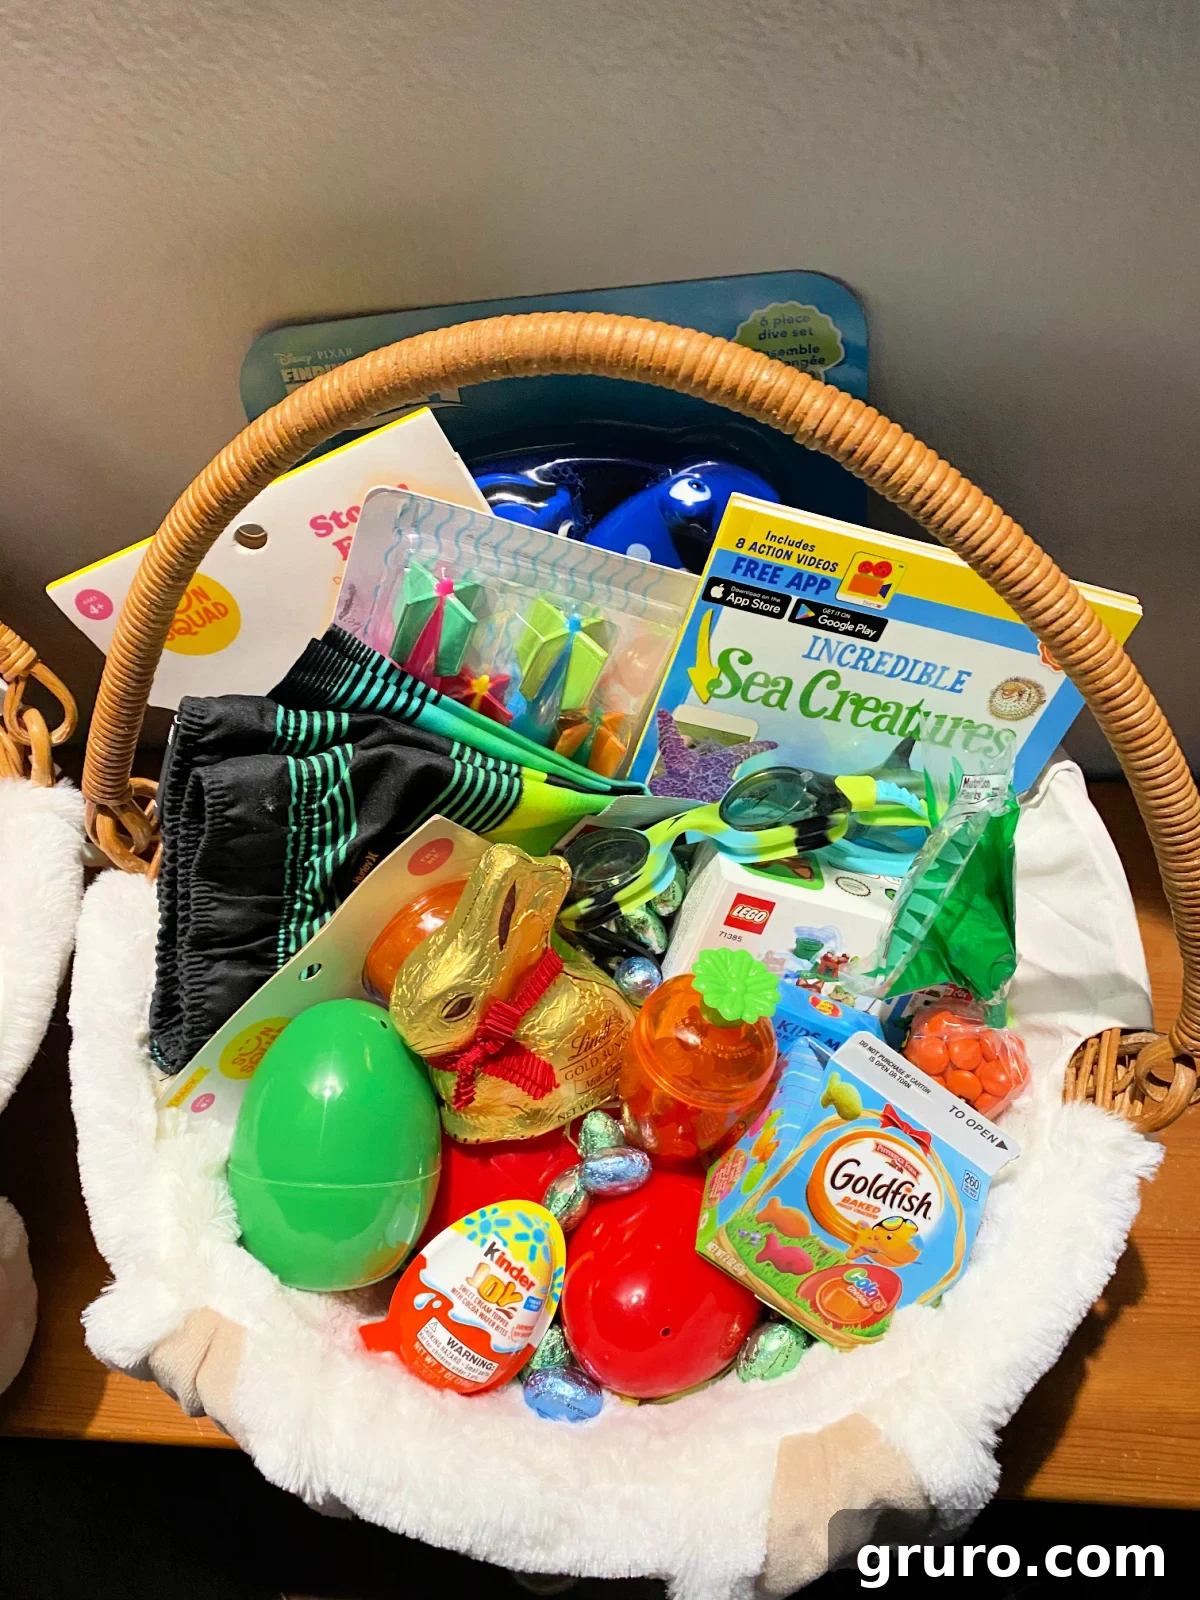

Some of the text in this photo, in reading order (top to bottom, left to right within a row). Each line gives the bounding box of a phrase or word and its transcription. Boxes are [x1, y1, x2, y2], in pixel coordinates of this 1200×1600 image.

[758, 327, 814, 341] dive set
[760, 314, 811, 328] 6 piece
[317, 347, 353, 361] PIXAR
[765, 530, 816, 553] Includes
[735, 537, 839, 573] 8 ACTION VIDEOS
[730, 556, 832, 596] FREE APP
[725, 592, 781, 614] App Store
[730, 585, 760, 599] Download
[770, 594, 781, 603] the
[817, 614, 877, 638] Google Play
[822, 607, 835, 616] GET
[841, 611, 852, 619] ON
[801, 634, 973, 695] INCREDIBLE
[705, 647, 1018, 761] Sea Creatures
[352, 859, 374, 885] Hurley
[730, 904, 770, 924] LEGO
[718, 930, 743, 943] 71385
[564, 1056, 599, 1081] GOLD
[859, 1039, 869, 1048] DO
[867, 1046, 880, 1056] NOT
[877, 1053, 906, 1076] PURCHASE
[909, 1077, 932, 1094] CARTON
[868, 1055, 912, 1089] IS OPEN OR TORN
[557, 1107, 576, 1121] NET
[949, 1104, 998, 1144] TO OPEN
[829, 1158, 933, 1220] Goldfish
[964, 1172, 980, 1190] 260
[841, 1195, 882, 1214] BAKED
[705, 1241, 720, 1253] NET
[843, 1267, 888, 1313] Colors
[450, 1286, 464, 1302] WITH
[461, 1297, 480, 1315] COCOA
[478, 1312, 497, 1330] WAFER
[494, 1323, 509, 1337] BITES
[459, 1283, 476, 1300] SWEET
[473, 1296, 493, 1315] CREAM
[491, 1310, 510, 1328] TOPPED
[413, 1340, 427, 1357] NET
[424, 1354, 438, 1367] WT
[443, 1371, 457, 1381] OZ
[423, 1326, 442, 1349] CHOKING
[440, 1343, 462, 1365] HAZARD
[464, 1363, 479, 1373] Small
[431, 1348, 452, 1367] children
[451, 1364, 467, 1376] under
[446, 1336, 495, 1372] WARNING:
